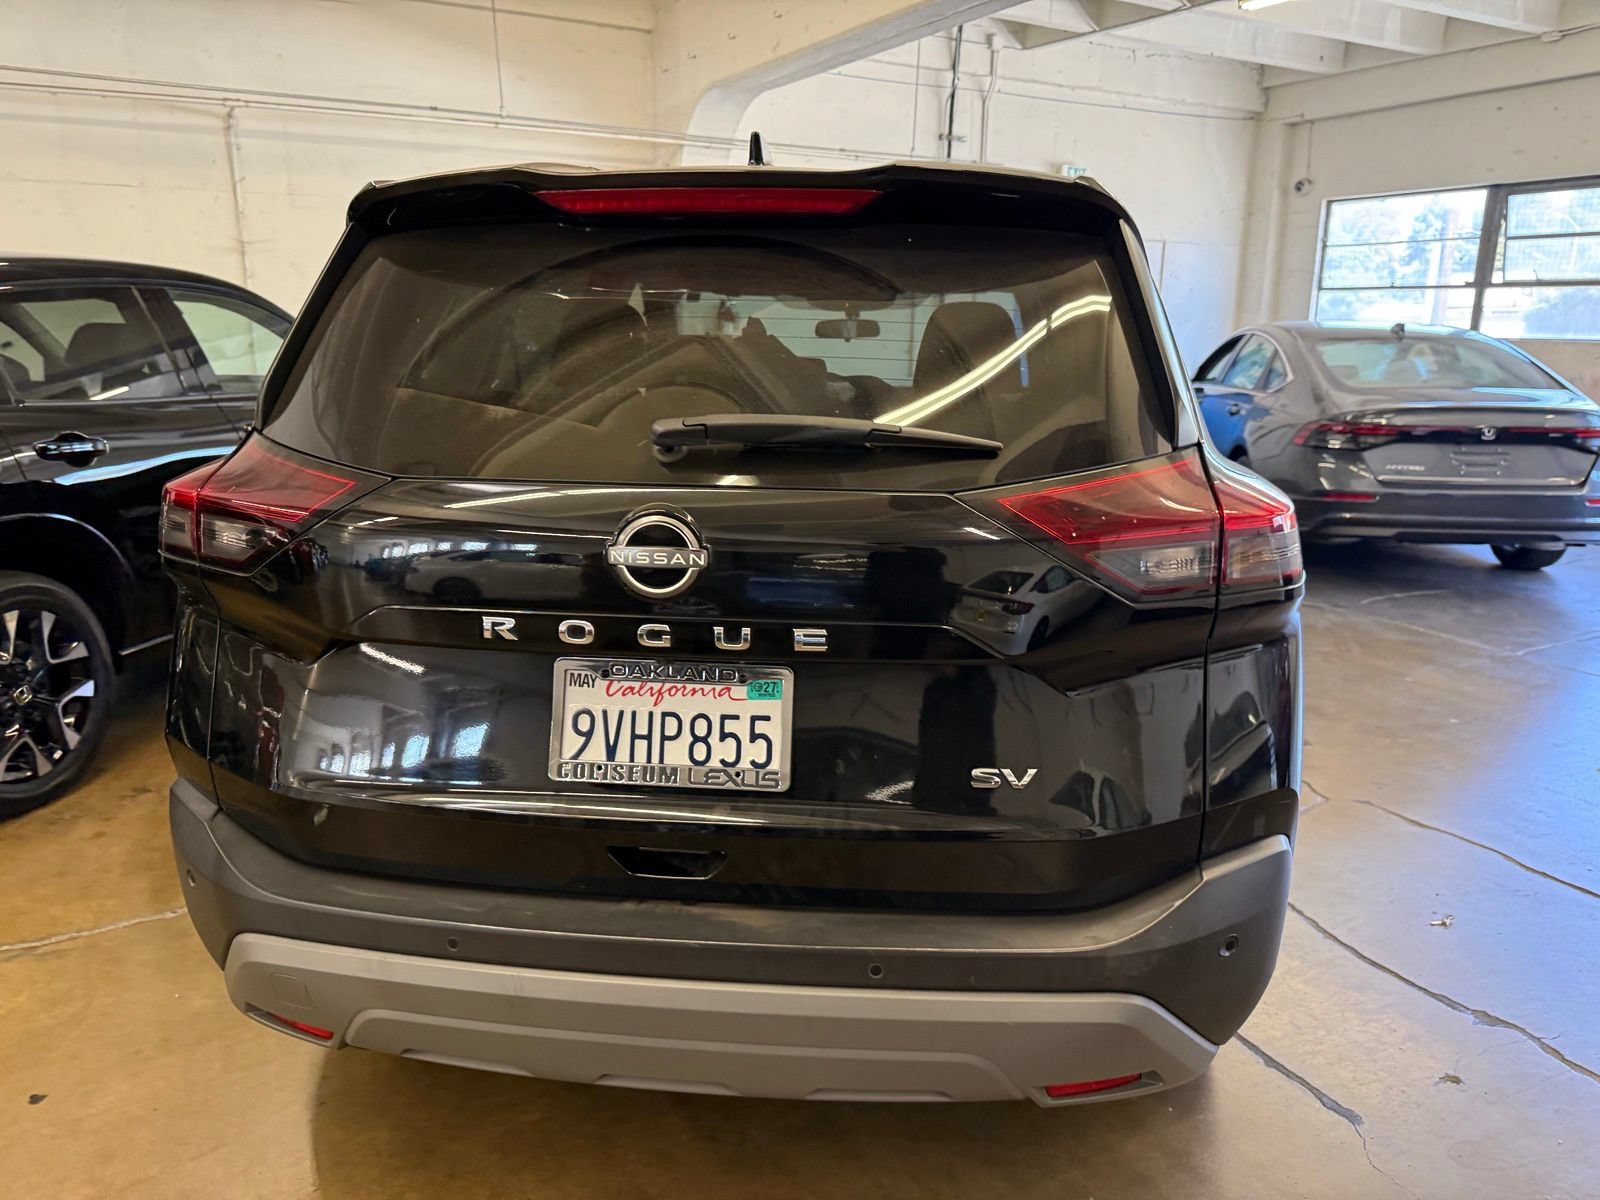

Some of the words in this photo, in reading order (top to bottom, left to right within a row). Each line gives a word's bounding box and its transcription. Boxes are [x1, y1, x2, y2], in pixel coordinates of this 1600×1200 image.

[609, 549, 706, 567] NISSAN
[481, 615, 829, 652] ROGUE
[569, 672, 598, 689] MAY
[609, 662, 739, 683] OAKLAND
[605, 679, 748, 707] California
[763, 681, 776, 693] 27
[568, 707, 774, 769] 9VHP855
[557, 762, 681, 785] COLISEUM
[687, 767, 781, 789] LEXUS
[970, 767, 1038, 789] SV
